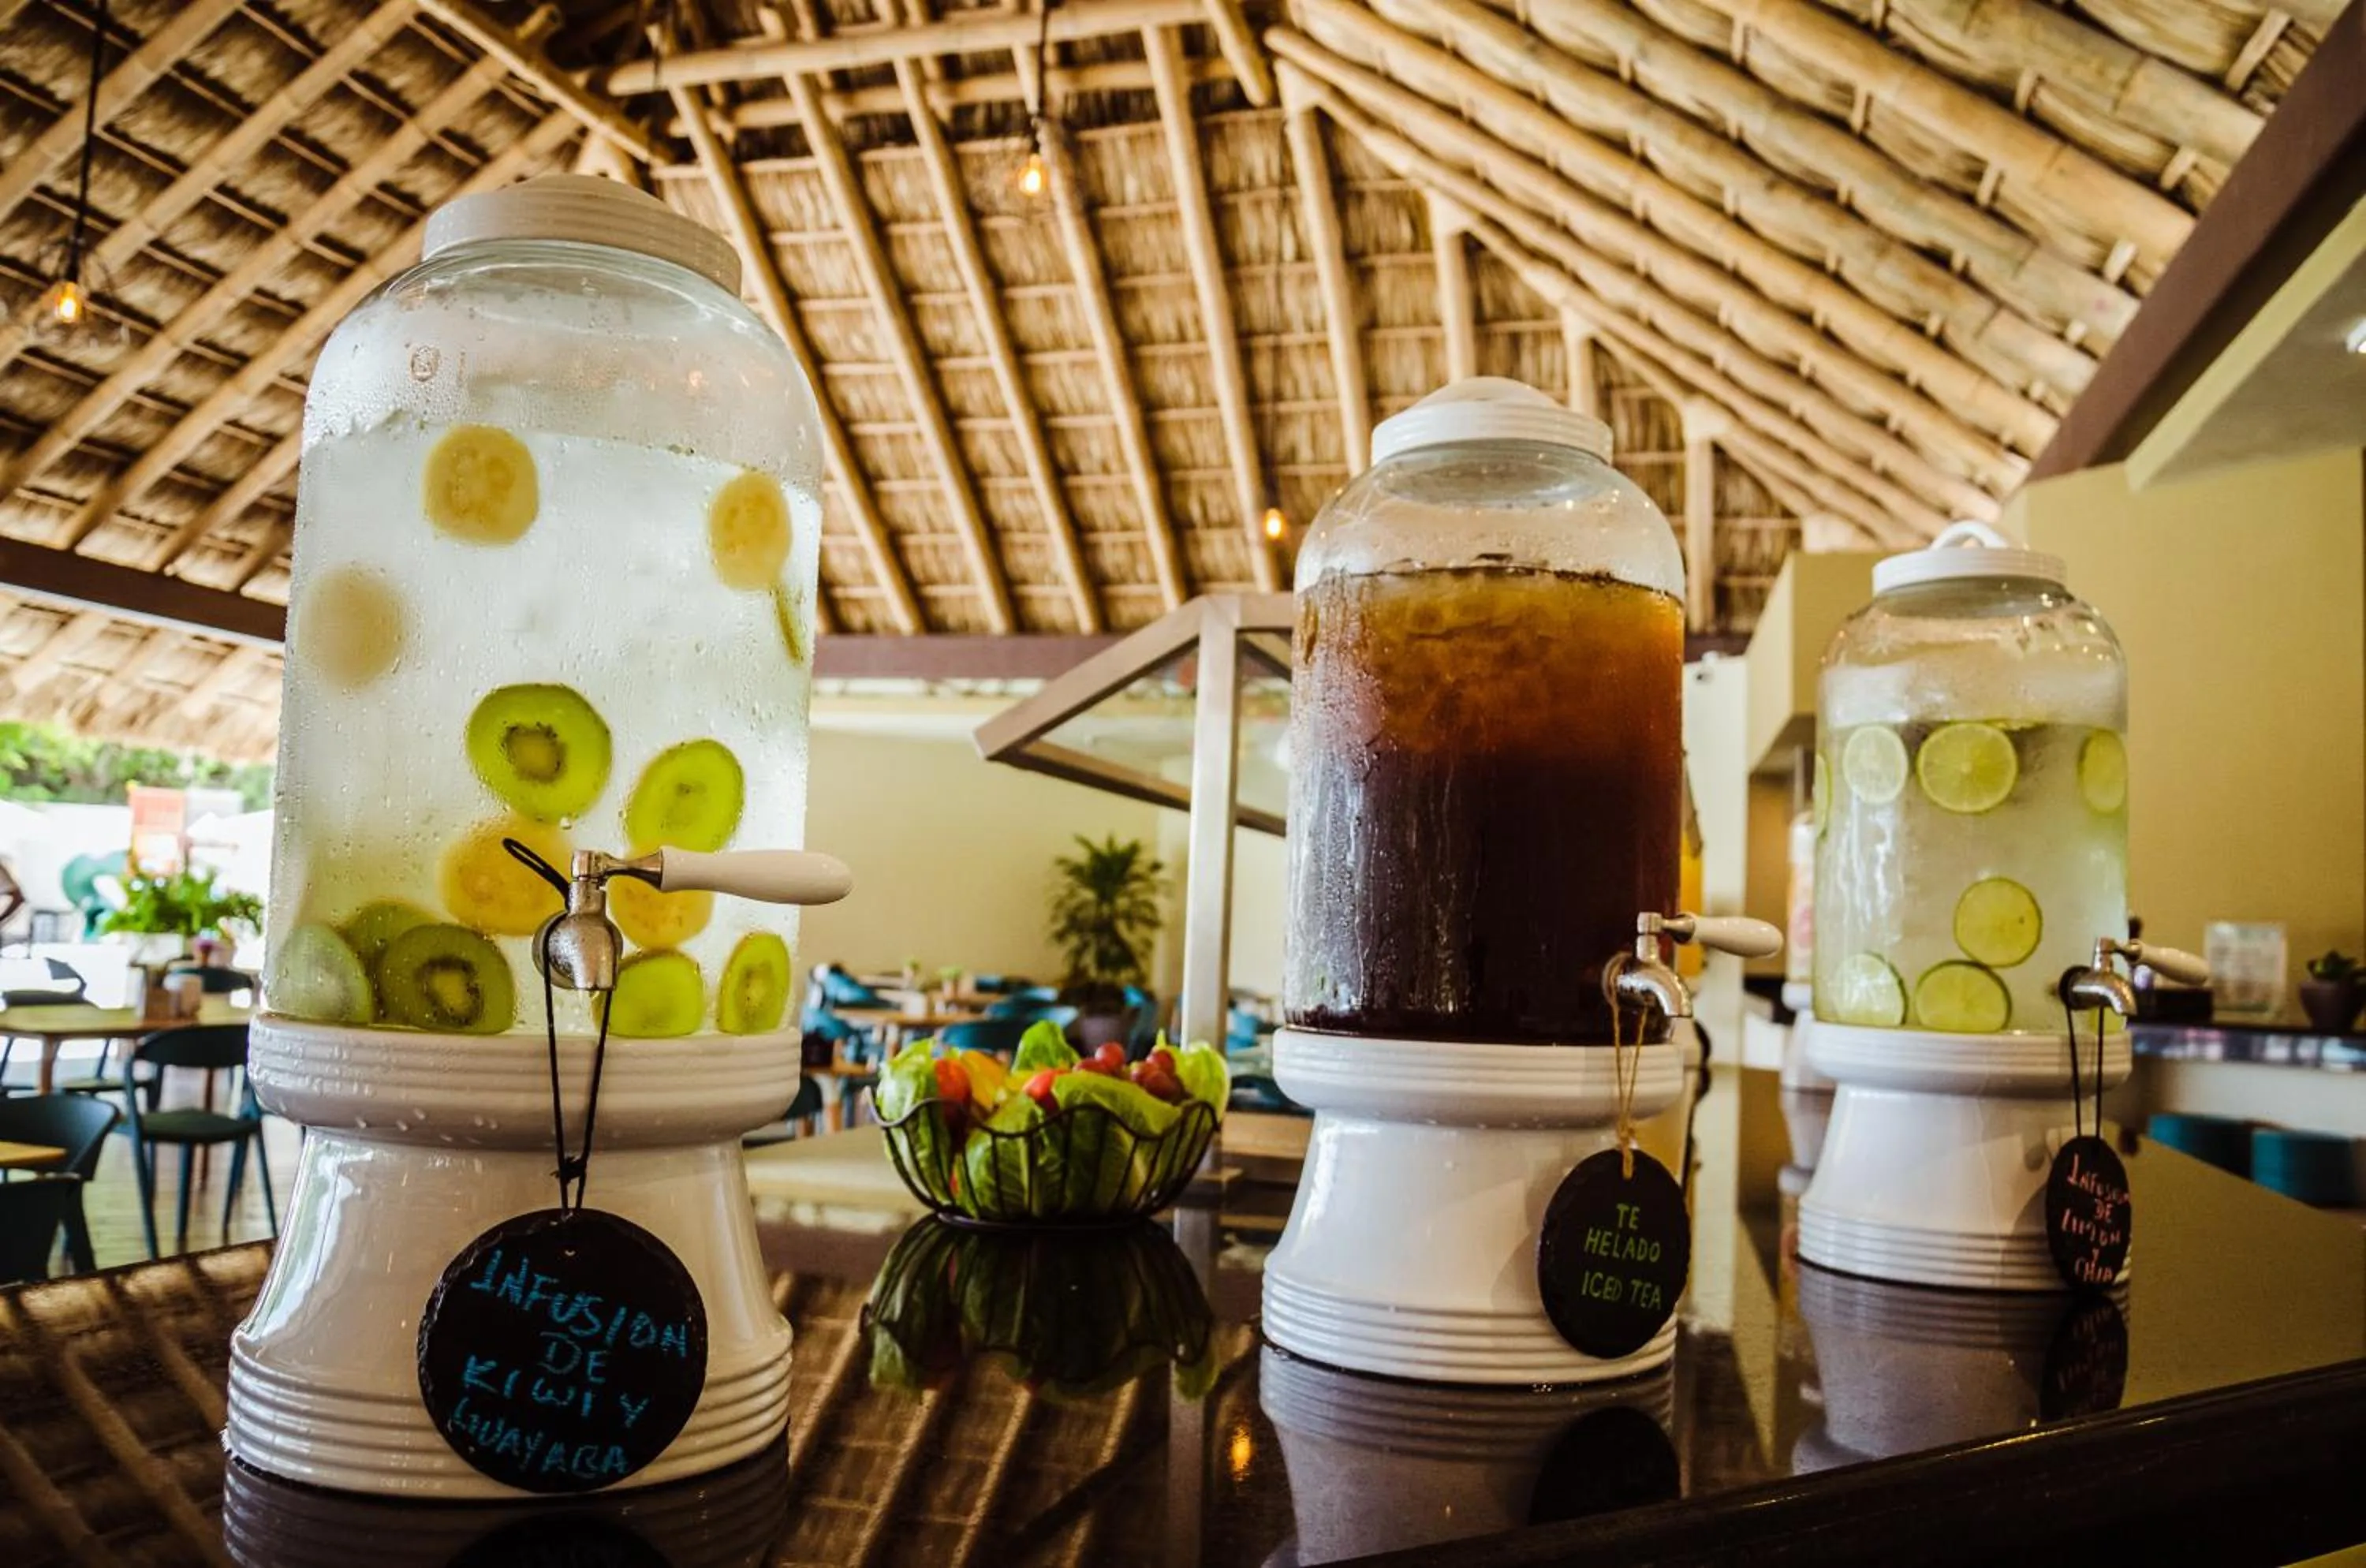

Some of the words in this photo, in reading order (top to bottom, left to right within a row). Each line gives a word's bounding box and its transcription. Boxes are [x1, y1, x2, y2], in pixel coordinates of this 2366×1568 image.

[1617, 1203, 1641, 1230] TE
[1584, 1227, 1662, 1263] HELADO
[471, 1249, 689, 1357] INFUSION
[1581, 1271, 1623, 1303] ICED
[1630, 1279, 1662, 1311] TEA
[536, 1331, 610, 1383] DE
[462, 1354, 595, 1417] KIWI
[619, 1392, 650, 1428] Y
